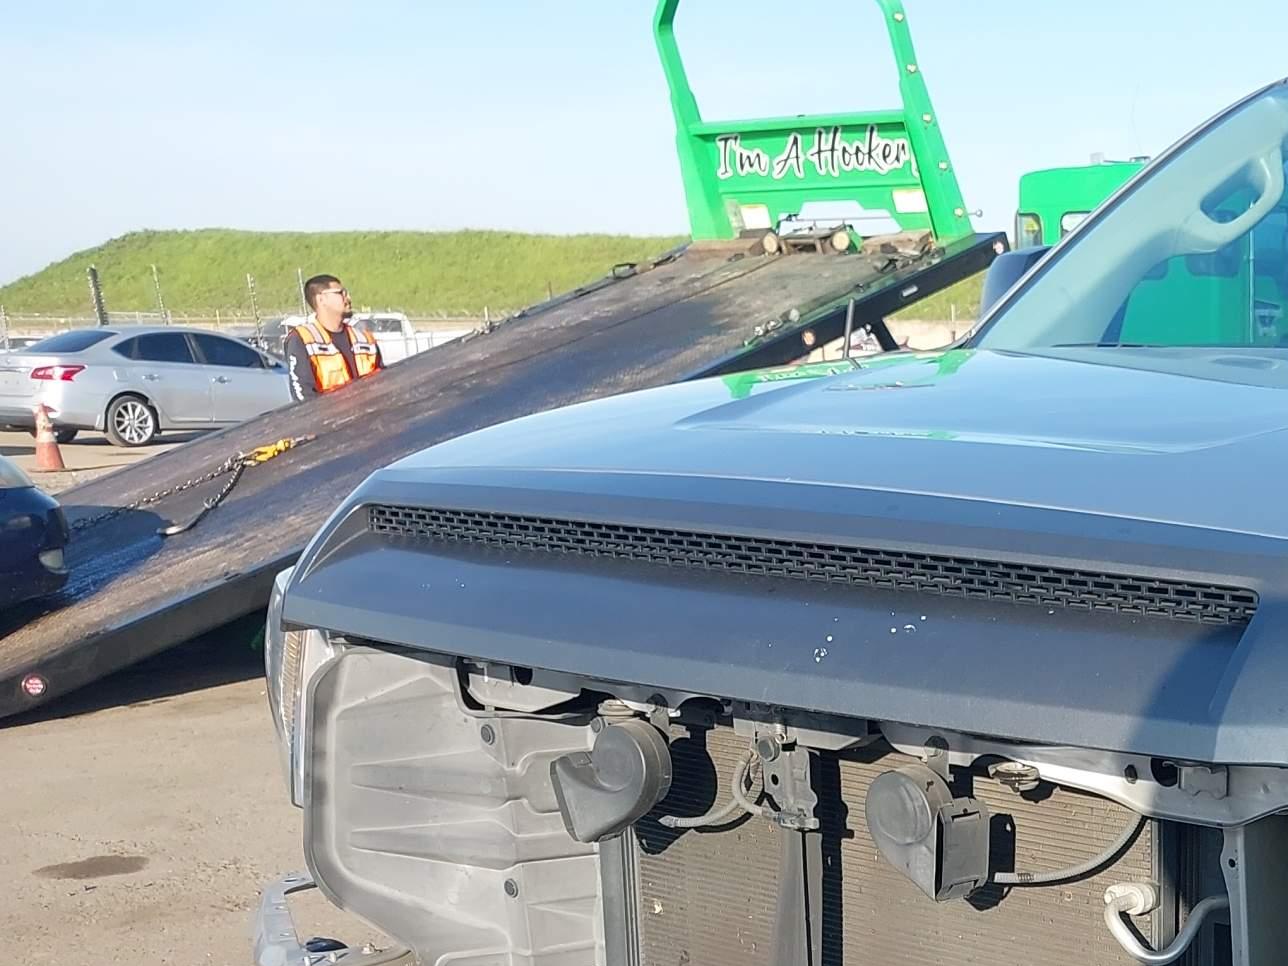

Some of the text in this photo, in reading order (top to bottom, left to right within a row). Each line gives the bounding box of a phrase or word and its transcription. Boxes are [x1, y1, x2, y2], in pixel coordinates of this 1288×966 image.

[717, 125, 906, 176] I'm A Hooker
